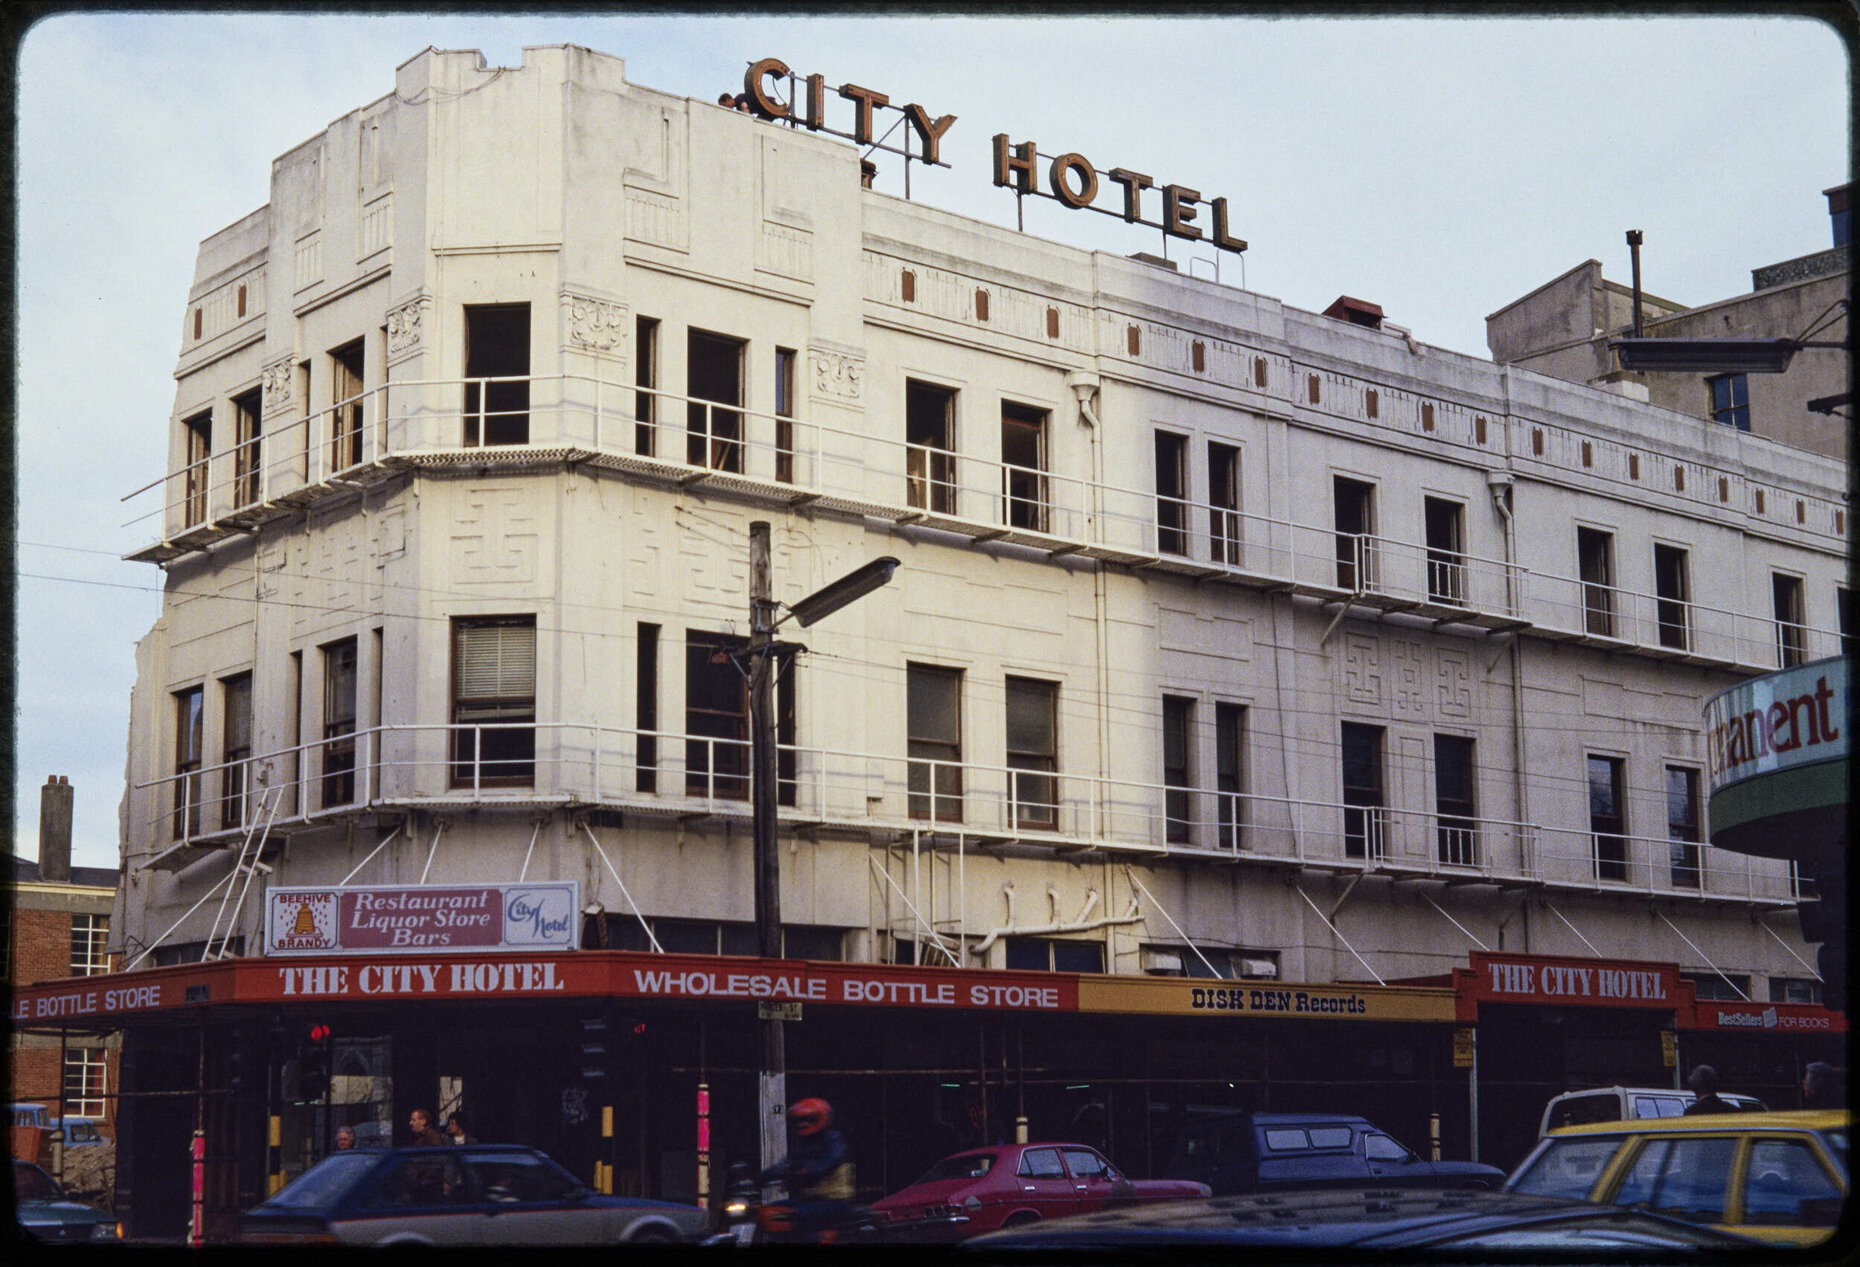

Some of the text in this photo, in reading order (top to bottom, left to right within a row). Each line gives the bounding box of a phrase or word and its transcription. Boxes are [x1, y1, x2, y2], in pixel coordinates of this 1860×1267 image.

[744, 58, 1248, 252] CITY HOTEL
[279, 893, 332, 904] BEEHIVE
[354, 891, 489, 911] Restaurant
[507, 893, 537, 922] City
[351, 909, 492, 933] Liquor Store
[532, 898, 570, 939] Hotel
[278, 938, 332, 949] BRANDY
[391, 929, 451, 946] Bars
[279, 962, 564, 995] THE CITY HOTEL
[634, 970, 1059, 1008] WHOLESALE BOTTLE STORE
[1488, 963, 1666, 1000] THE CITY HOTEL
[36, 992, 97, 1018] BOTTLE
[105, 985, 160, 1011] STORE
[1191, 988, 1367, 1014] DISK DEN Records
[1718, 1011, 1830, 1029] BestSellers FOR BOOKS
